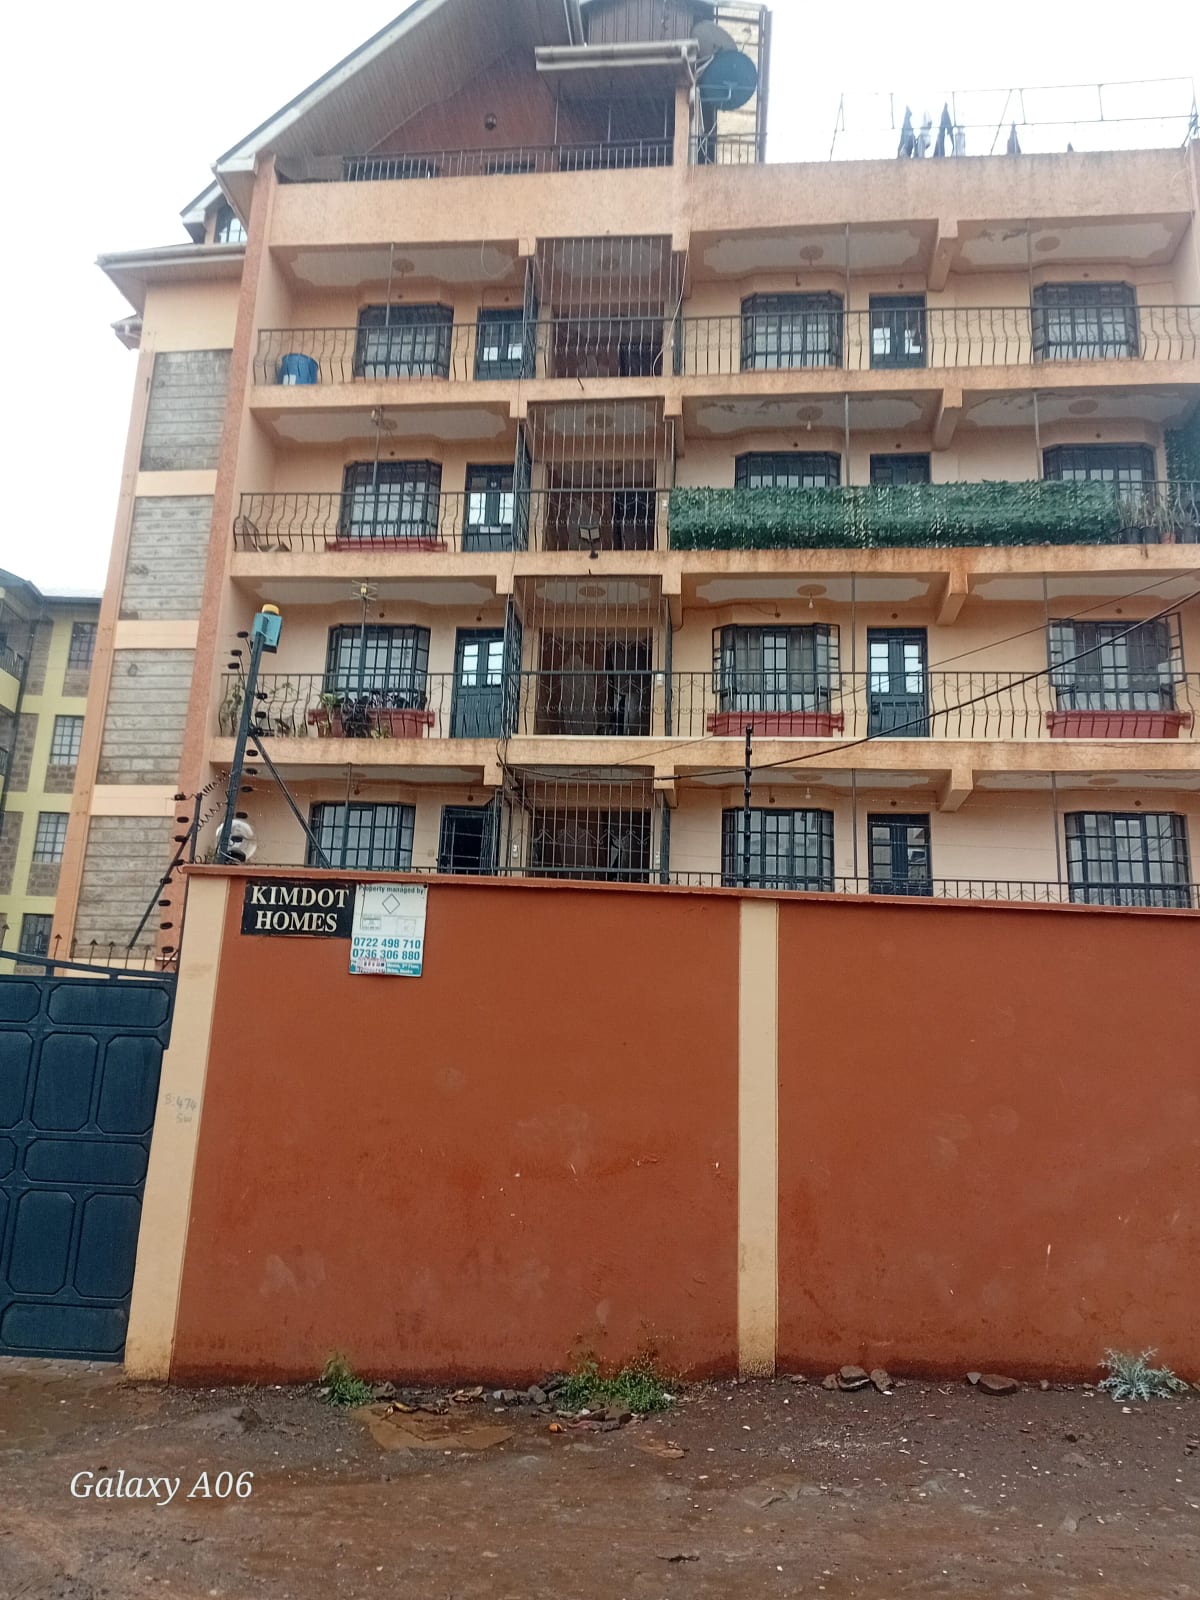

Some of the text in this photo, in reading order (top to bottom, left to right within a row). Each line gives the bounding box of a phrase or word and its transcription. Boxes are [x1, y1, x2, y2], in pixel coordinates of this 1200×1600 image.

[250, 885, 350, 908] KIMDOT
[386, 886, 415, 895] managed
[255, 911, 338, 932] HOMES
[353, 937, 421, 949] 0722 498 710
[352, 948, 420, 961] 0736 306 880
